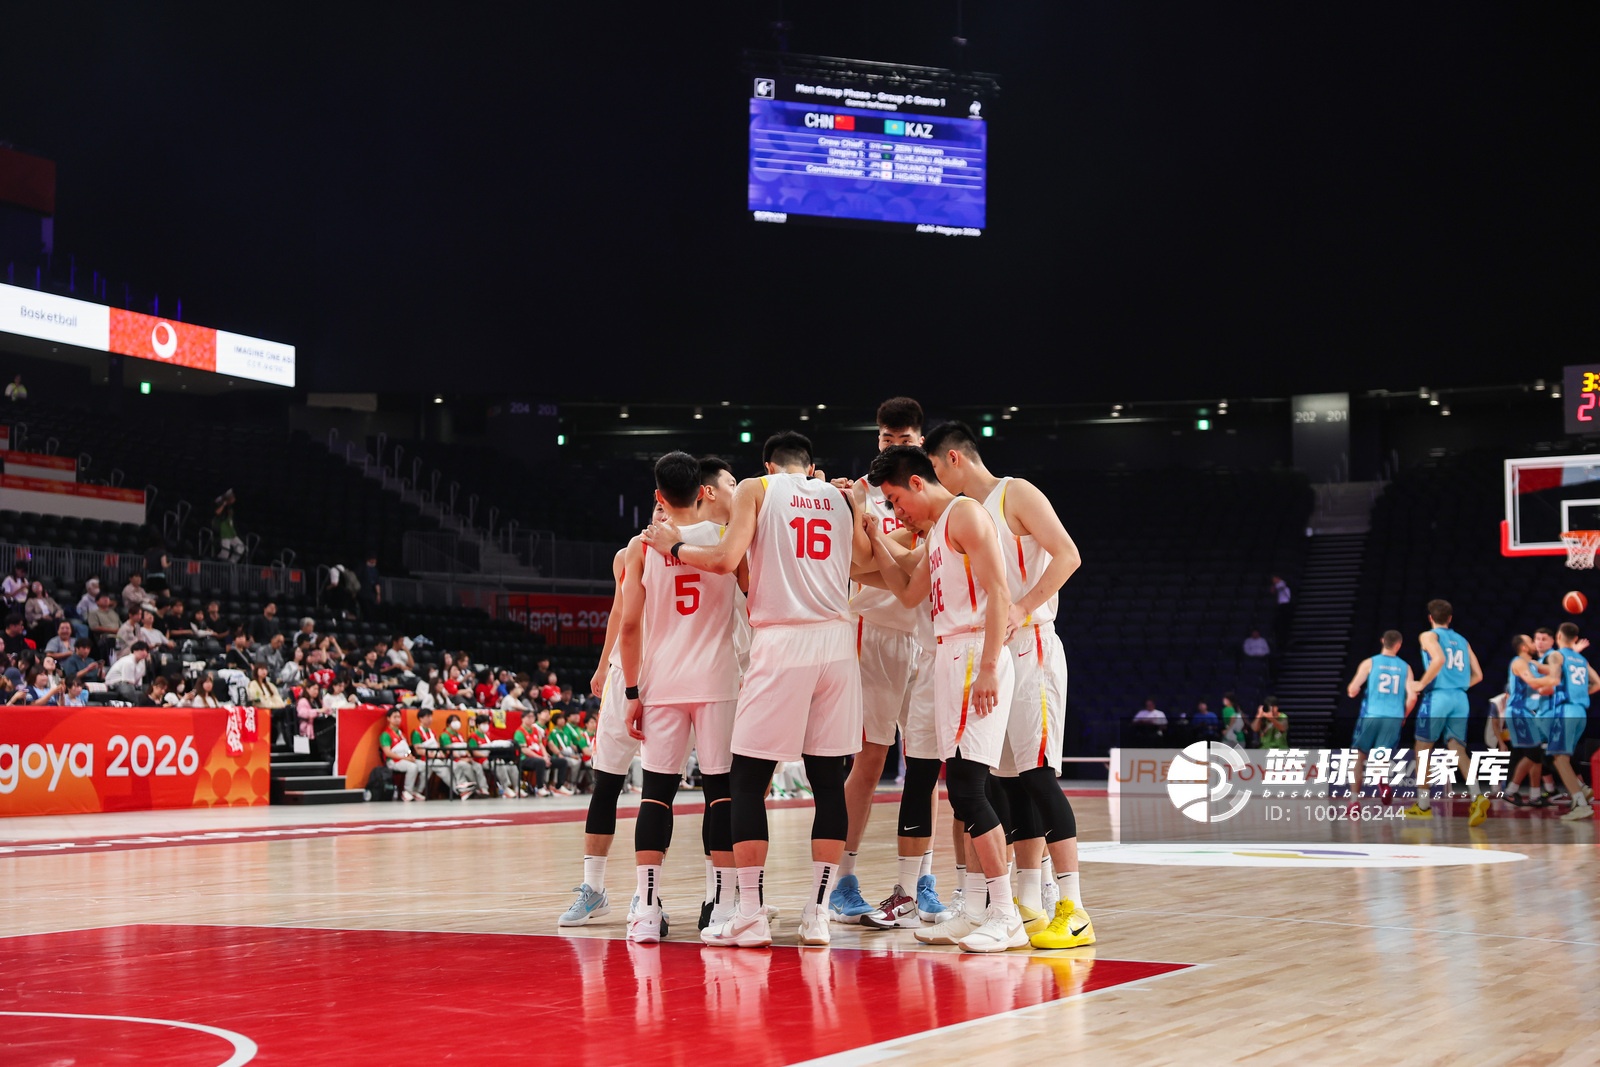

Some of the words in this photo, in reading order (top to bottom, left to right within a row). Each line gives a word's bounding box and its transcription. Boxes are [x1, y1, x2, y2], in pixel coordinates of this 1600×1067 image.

[815, 85, 842, 99] Group
[843, 88, 871, 100] Phase
[877, 92, 905, 105] Group
[914, 95, 940, 107] Game
[804, 112, 834, 129] CHN
[905, 122, 934, 139] KAZ
[20, 305, 77, 328] Basketball
[234, 345, 264, 358] IMAGINE
[790, 495, 813, 509] JIAO
[815, 497, 834, 511] B.Q.
[789, 516, 832, 561] 16
[675, 573, 701, 615] 5
[1445, 647, 1464, 672] 14
[1378, 673, 1400, 695] 21
[106, 735, 199, 777] 2026
